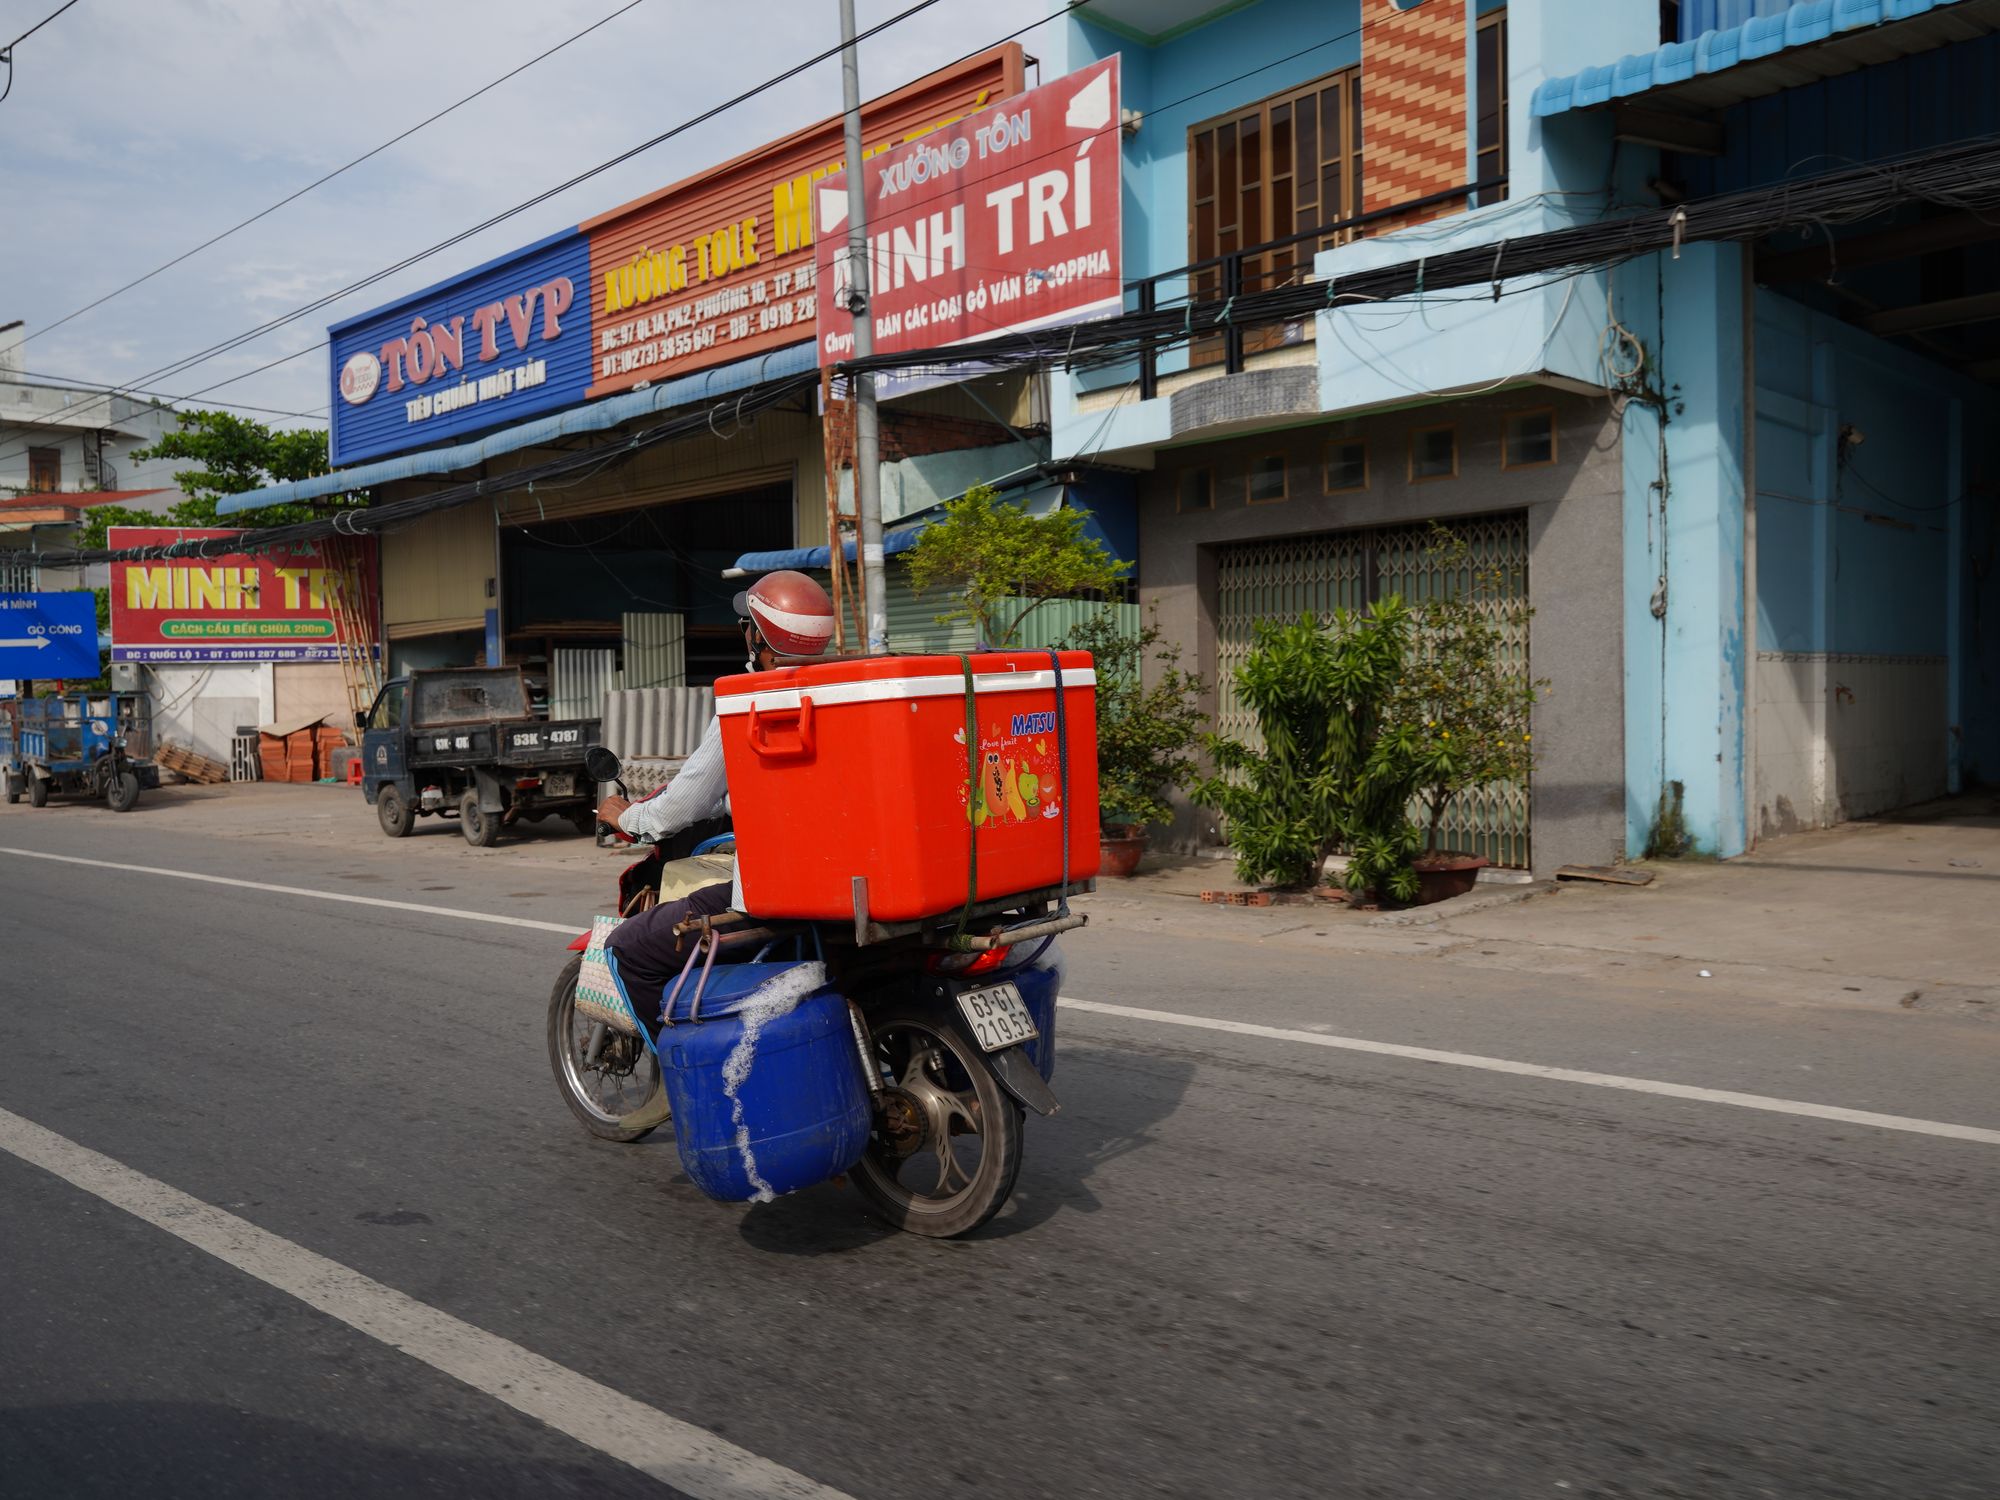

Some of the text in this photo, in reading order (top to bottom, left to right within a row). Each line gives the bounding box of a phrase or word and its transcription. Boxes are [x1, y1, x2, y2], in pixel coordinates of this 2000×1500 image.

[879, 143, 970, 199] XƯỞNG
[976, 109, 1032, 159] TÔN
[986, 137, 1096, 256] TRÍ
[604, 217, 760, 314] XƯỞNG TOLE
[876, 312, 902, 339] BÁN
[904, 303, 929, 331] CÁC
[931, 289, 961, 323] LOẠI
[990, 275, 1021, 304] VÁN
[1047, 249, 1111, 289] COPPHA
[760, 301, 794, 332] 0918
[797, 295, 817, 322] 28
[380, 277, 574, 392] TÔN TVP
[825, 331, 855, 354] Chuy
[405, 394, 433, 423] TIÊU
[126, 566, 260, 609] MINH
[294, 624, 326, 634] 200m
[149, 648, 177, 659] QUỐC
[513, 732, 539, 746] 63K
[550, 729, 578, 743] 4787
[1011, 711, 1056, 736] MATSU
[980, 736, 1017, 751] Love fruit
[977, 1011, 1034, 1047] 219.53
